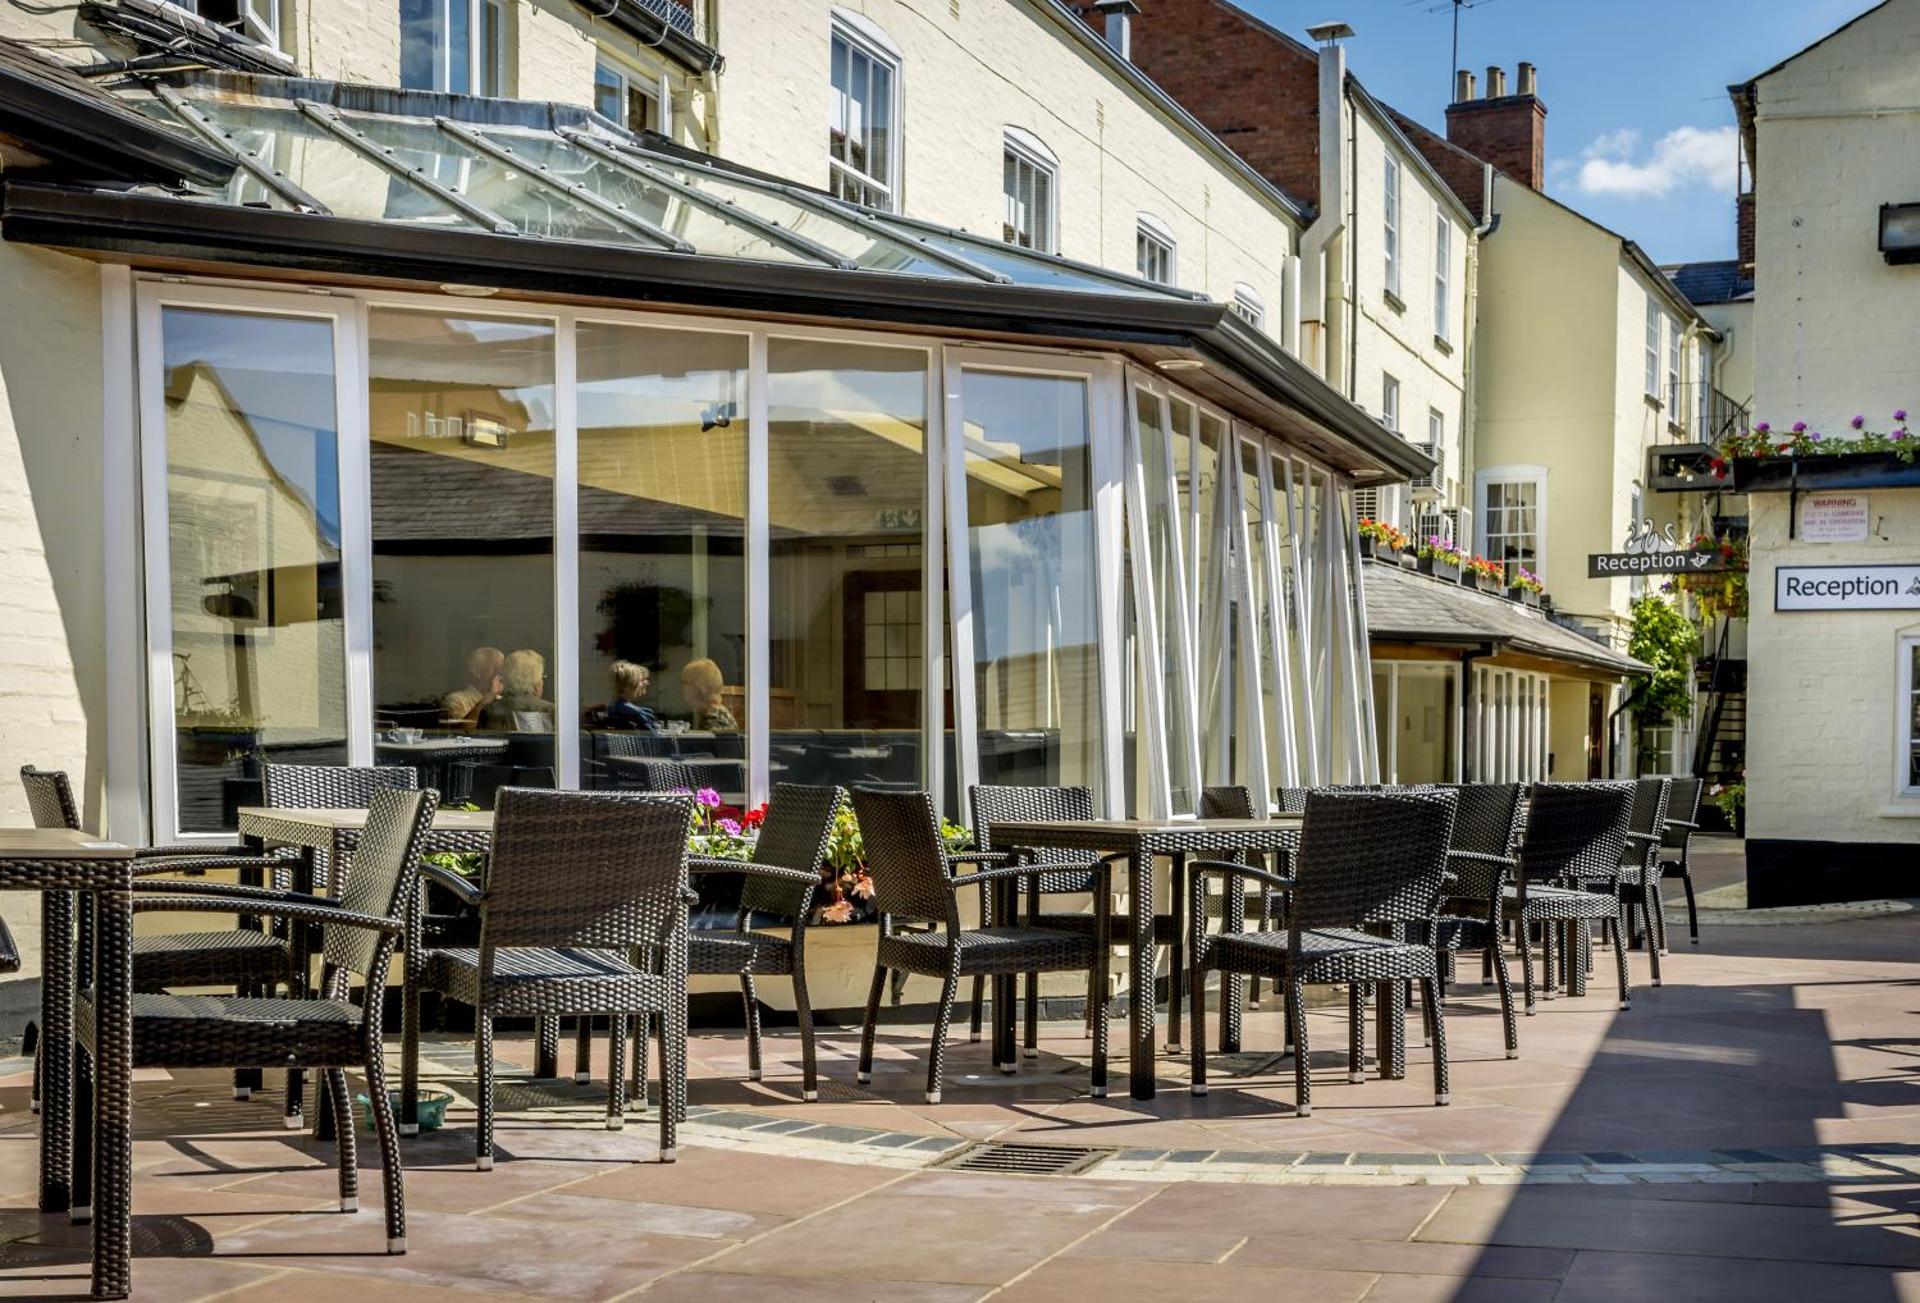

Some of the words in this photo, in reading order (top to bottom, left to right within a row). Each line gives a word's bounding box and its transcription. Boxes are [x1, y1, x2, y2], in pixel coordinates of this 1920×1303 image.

[1813, 498, 1857, 508] WARNING
[1597, 553, 1686, 571] Reception
[1787, 576, 1898, 600] Reception
